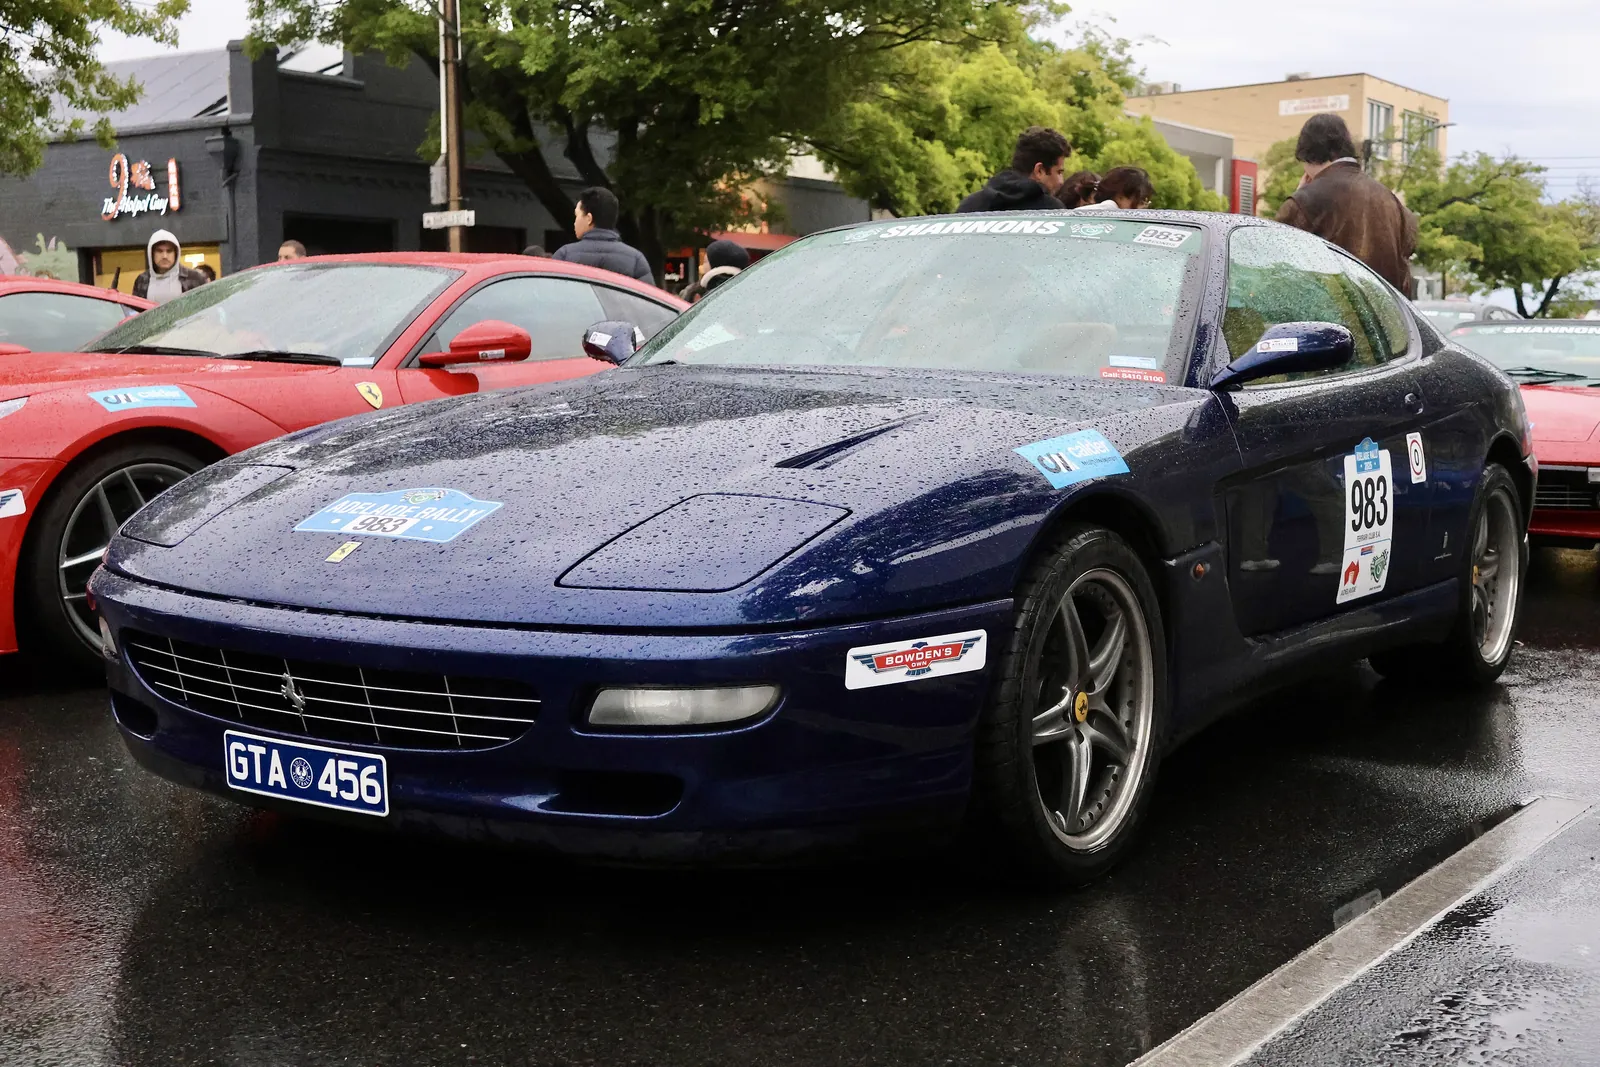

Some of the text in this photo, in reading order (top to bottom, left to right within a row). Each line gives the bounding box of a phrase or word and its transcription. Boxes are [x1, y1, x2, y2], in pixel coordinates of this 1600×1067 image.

[150, 194, 168, 215] Guy
[879, 220, 1065, 239] SHANNONS
[1142, 229, 1186, 242] 983
[326, 500, 487, 524] ADELAIDE RALLY
[1351, 475, 1388, 532] 983
[352, 516, 409, 533] 983
[885, 647, 952, 665] BOWDEN'S
[229, 741, 382, 805] GTA 456
